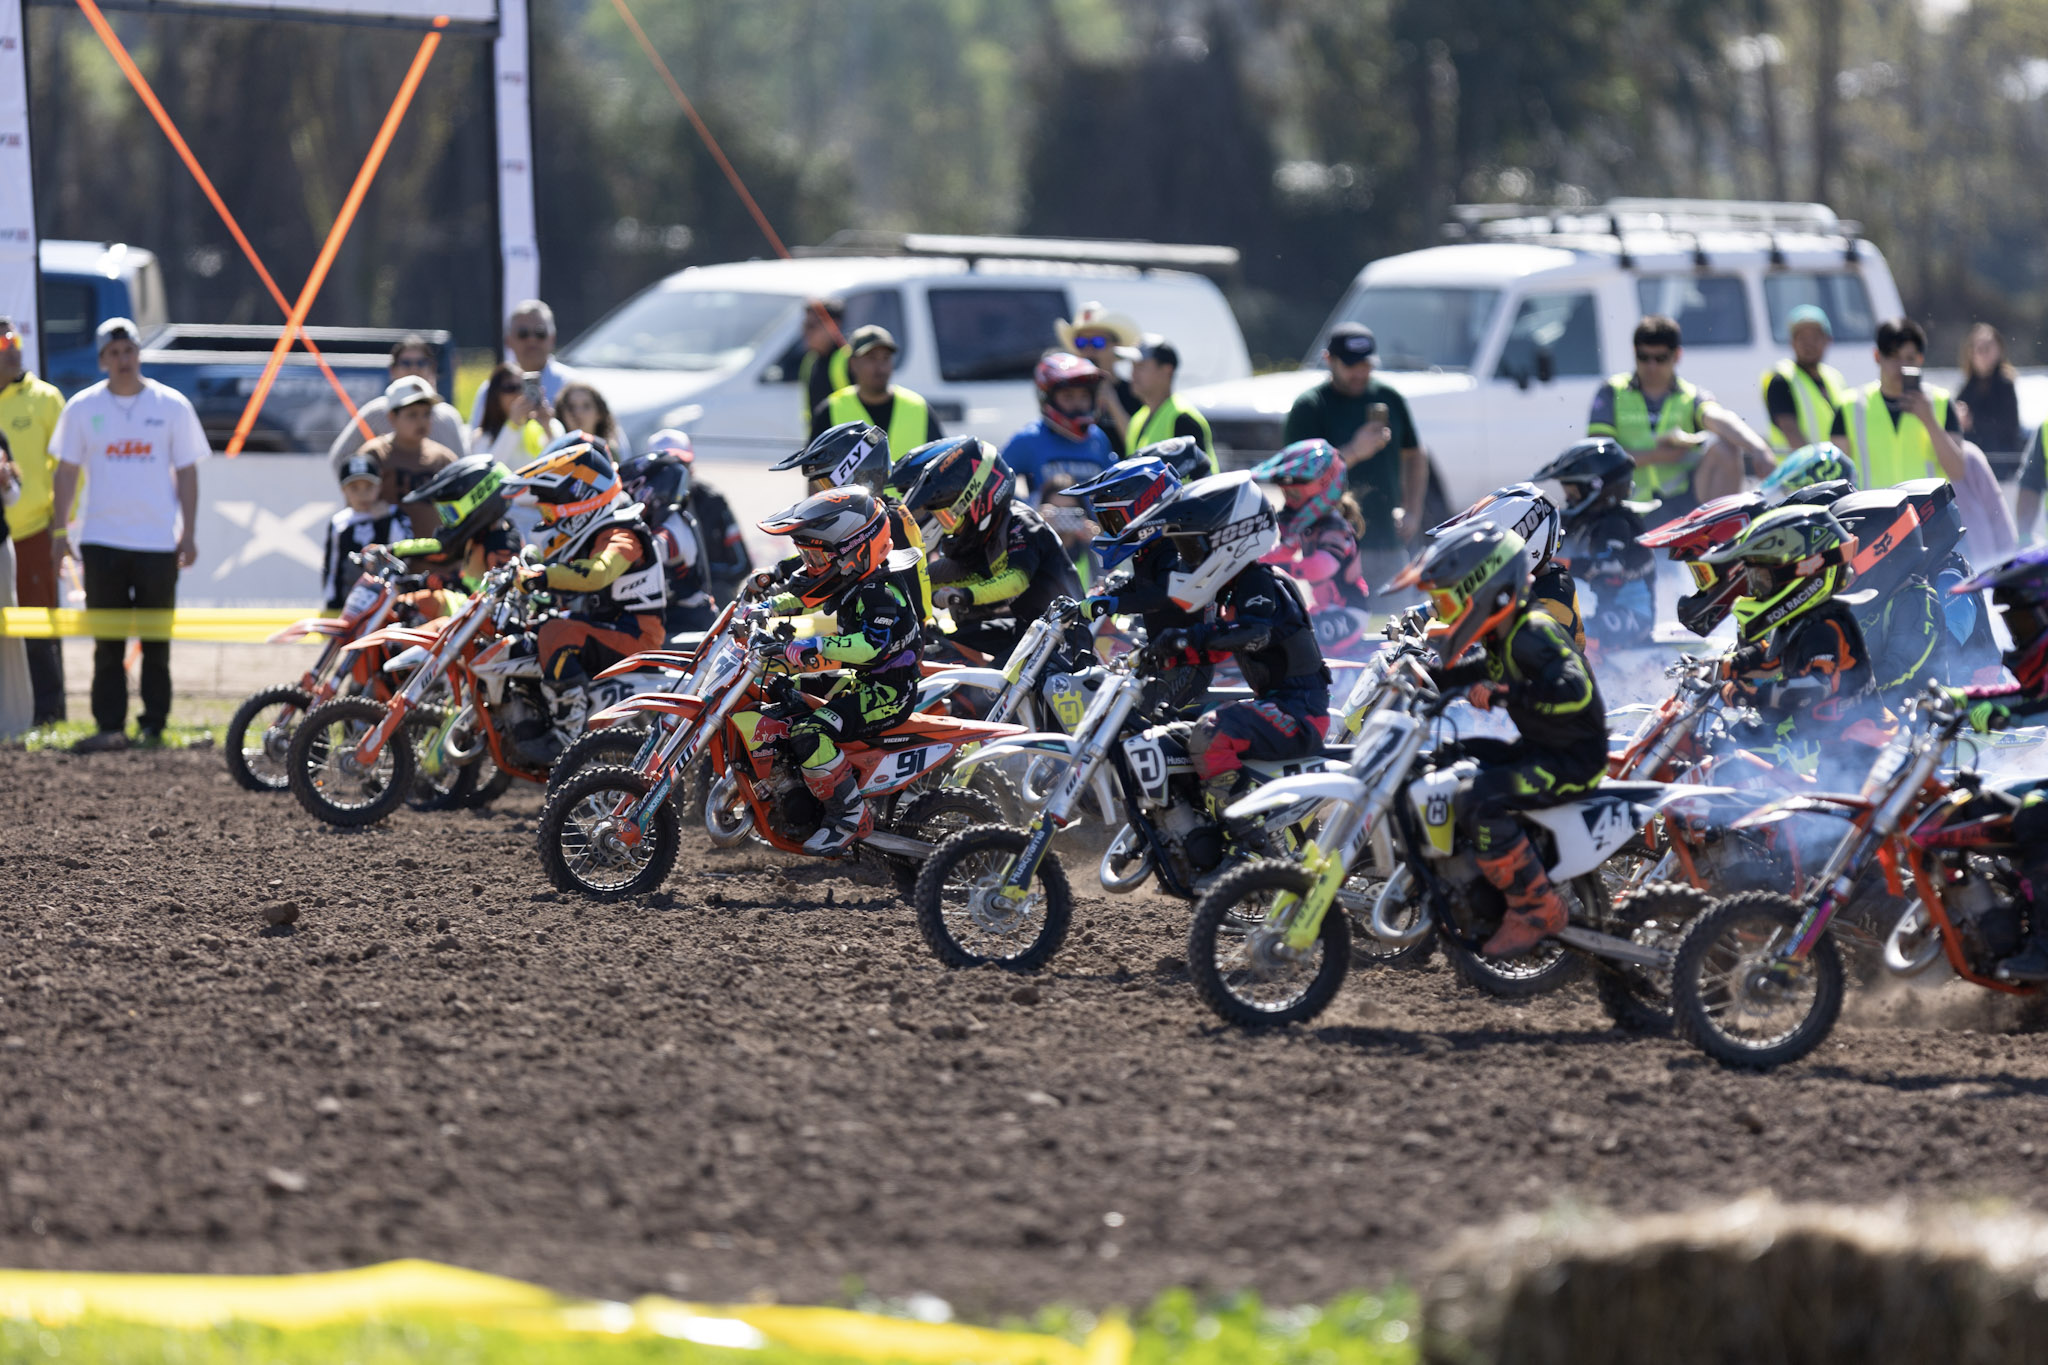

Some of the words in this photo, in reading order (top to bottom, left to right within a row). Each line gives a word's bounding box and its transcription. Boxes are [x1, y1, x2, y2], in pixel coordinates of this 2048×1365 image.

[838, 446, 863, 479] FLY
[1133, 472, 1167, 516] LEATT
[1208, 513, 1271, 549] 100%
[1514, 499, 1552, 540] 00%
[620, 575, 649, 594] FOX
[1455, 556, 1503, 606] 100%
[1766, 604, 1788, 624] FOX
[1786, 578, 1824, 612] RACING
[895, 747, 928, 778] 91
[647, 783, 671, 813] MOTOREX
[1009, 830, 1046, 883] Husqvarna
